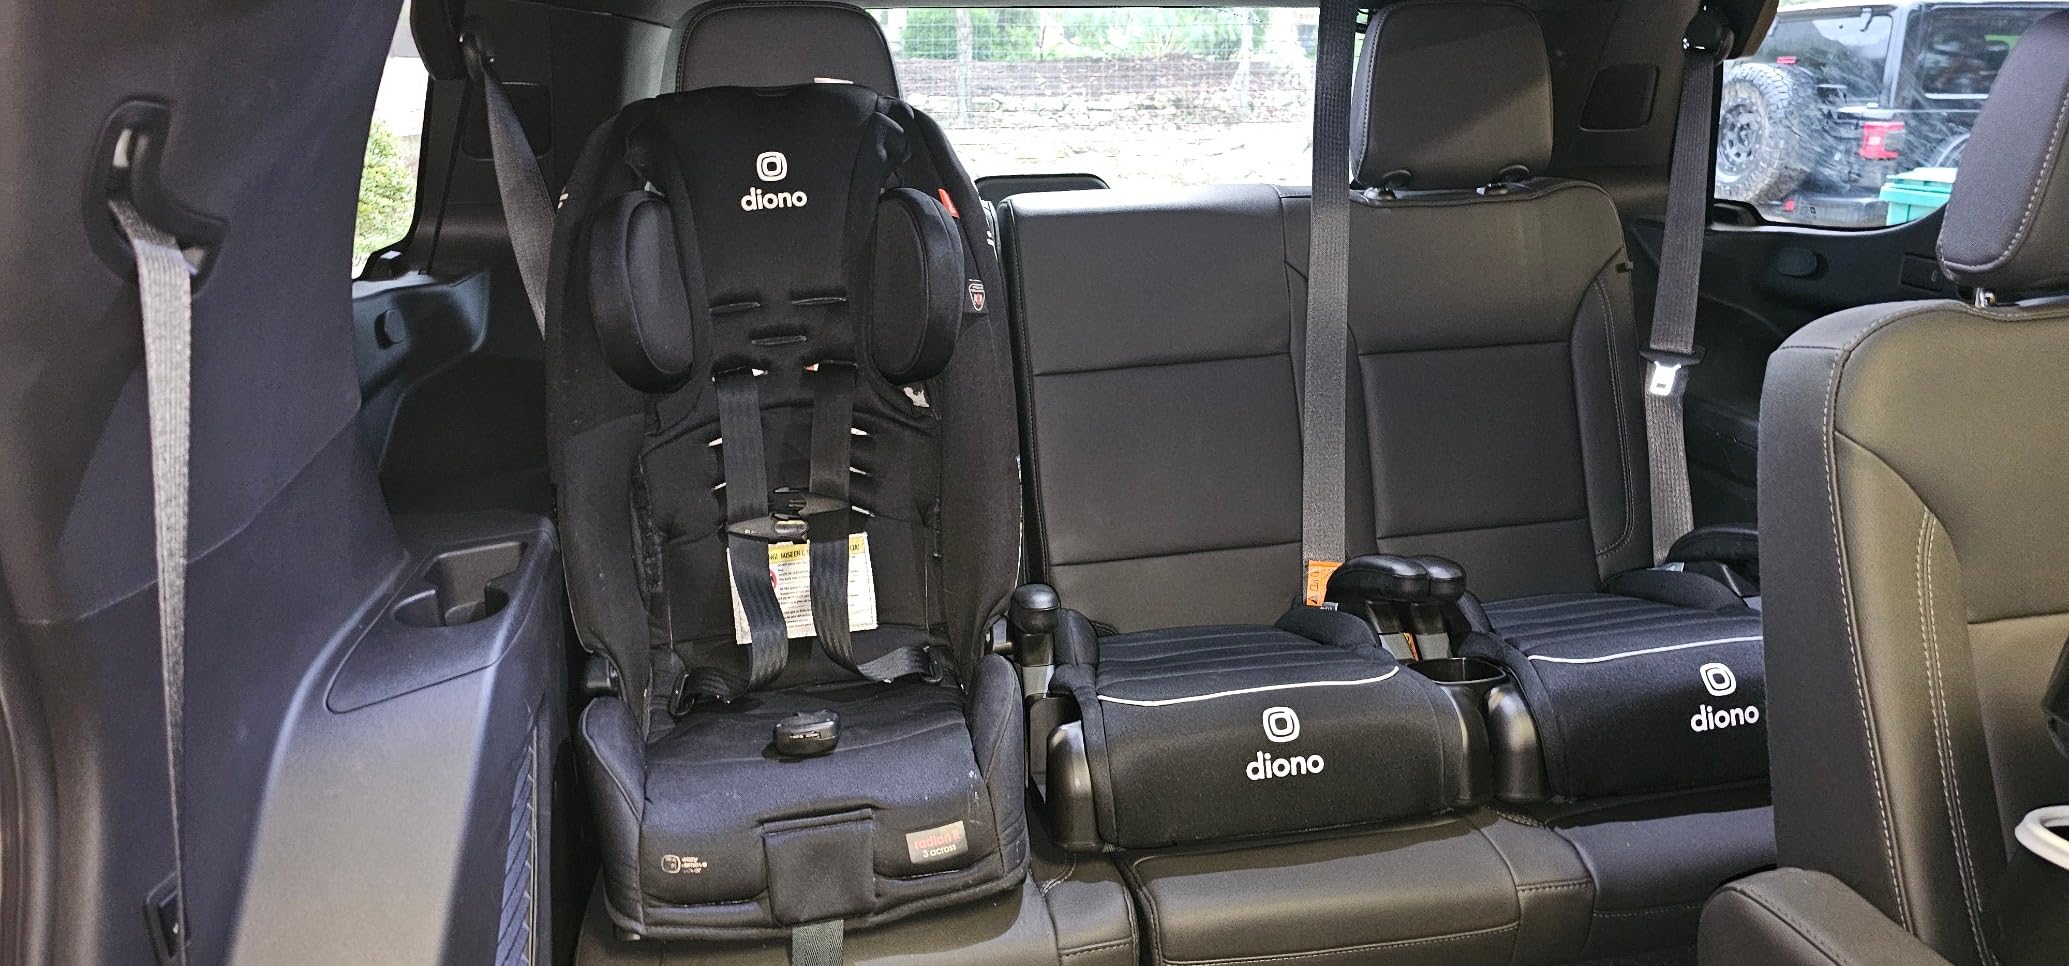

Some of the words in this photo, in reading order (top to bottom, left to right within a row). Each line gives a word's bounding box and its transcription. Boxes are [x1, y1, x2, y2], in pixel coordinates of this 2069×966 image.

[741, 187, 808, 212] diono
[1691, 704, 1760, 732] diono
[1246, 751, 1325, 781] diono
[922, 850, 929, 858] 3
[930, 844, 957, 857] across
